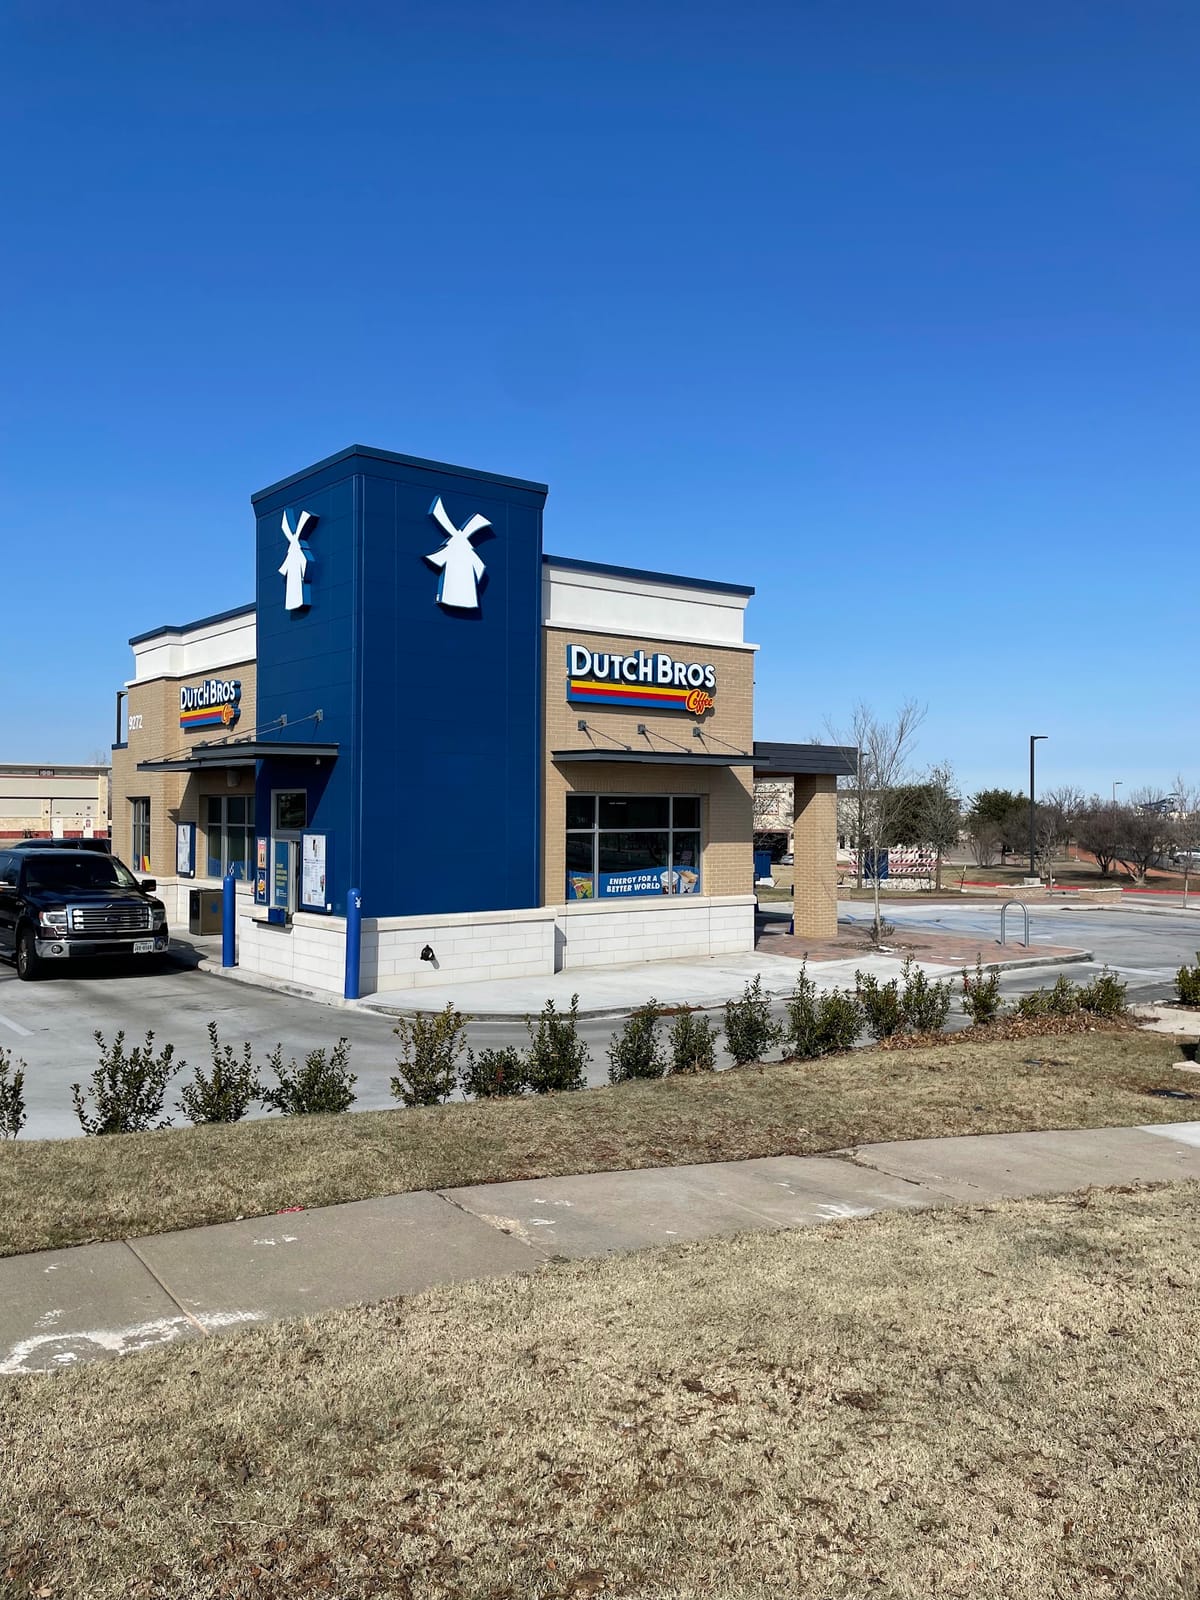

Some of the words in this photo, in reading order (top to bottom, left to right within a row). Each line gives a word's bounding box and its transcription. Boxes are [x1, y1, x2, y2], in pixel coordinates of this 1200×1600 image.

[570, 644, 653, 682] DUTCH
[657, 653, 717, 688] BROS
[180, 680, 209, 709] DUTCH
[210, 679, 236, 705] BROS
[685, 688, 713, 715] Coffee
[128, 714, 143, 731] 9272
[606, 885, 632, 893] BETTER
[634, 882, 660, 890] WORLD
[609, 877, 636, 885] ENERGY
[638, 875, 651, 883] FOR
